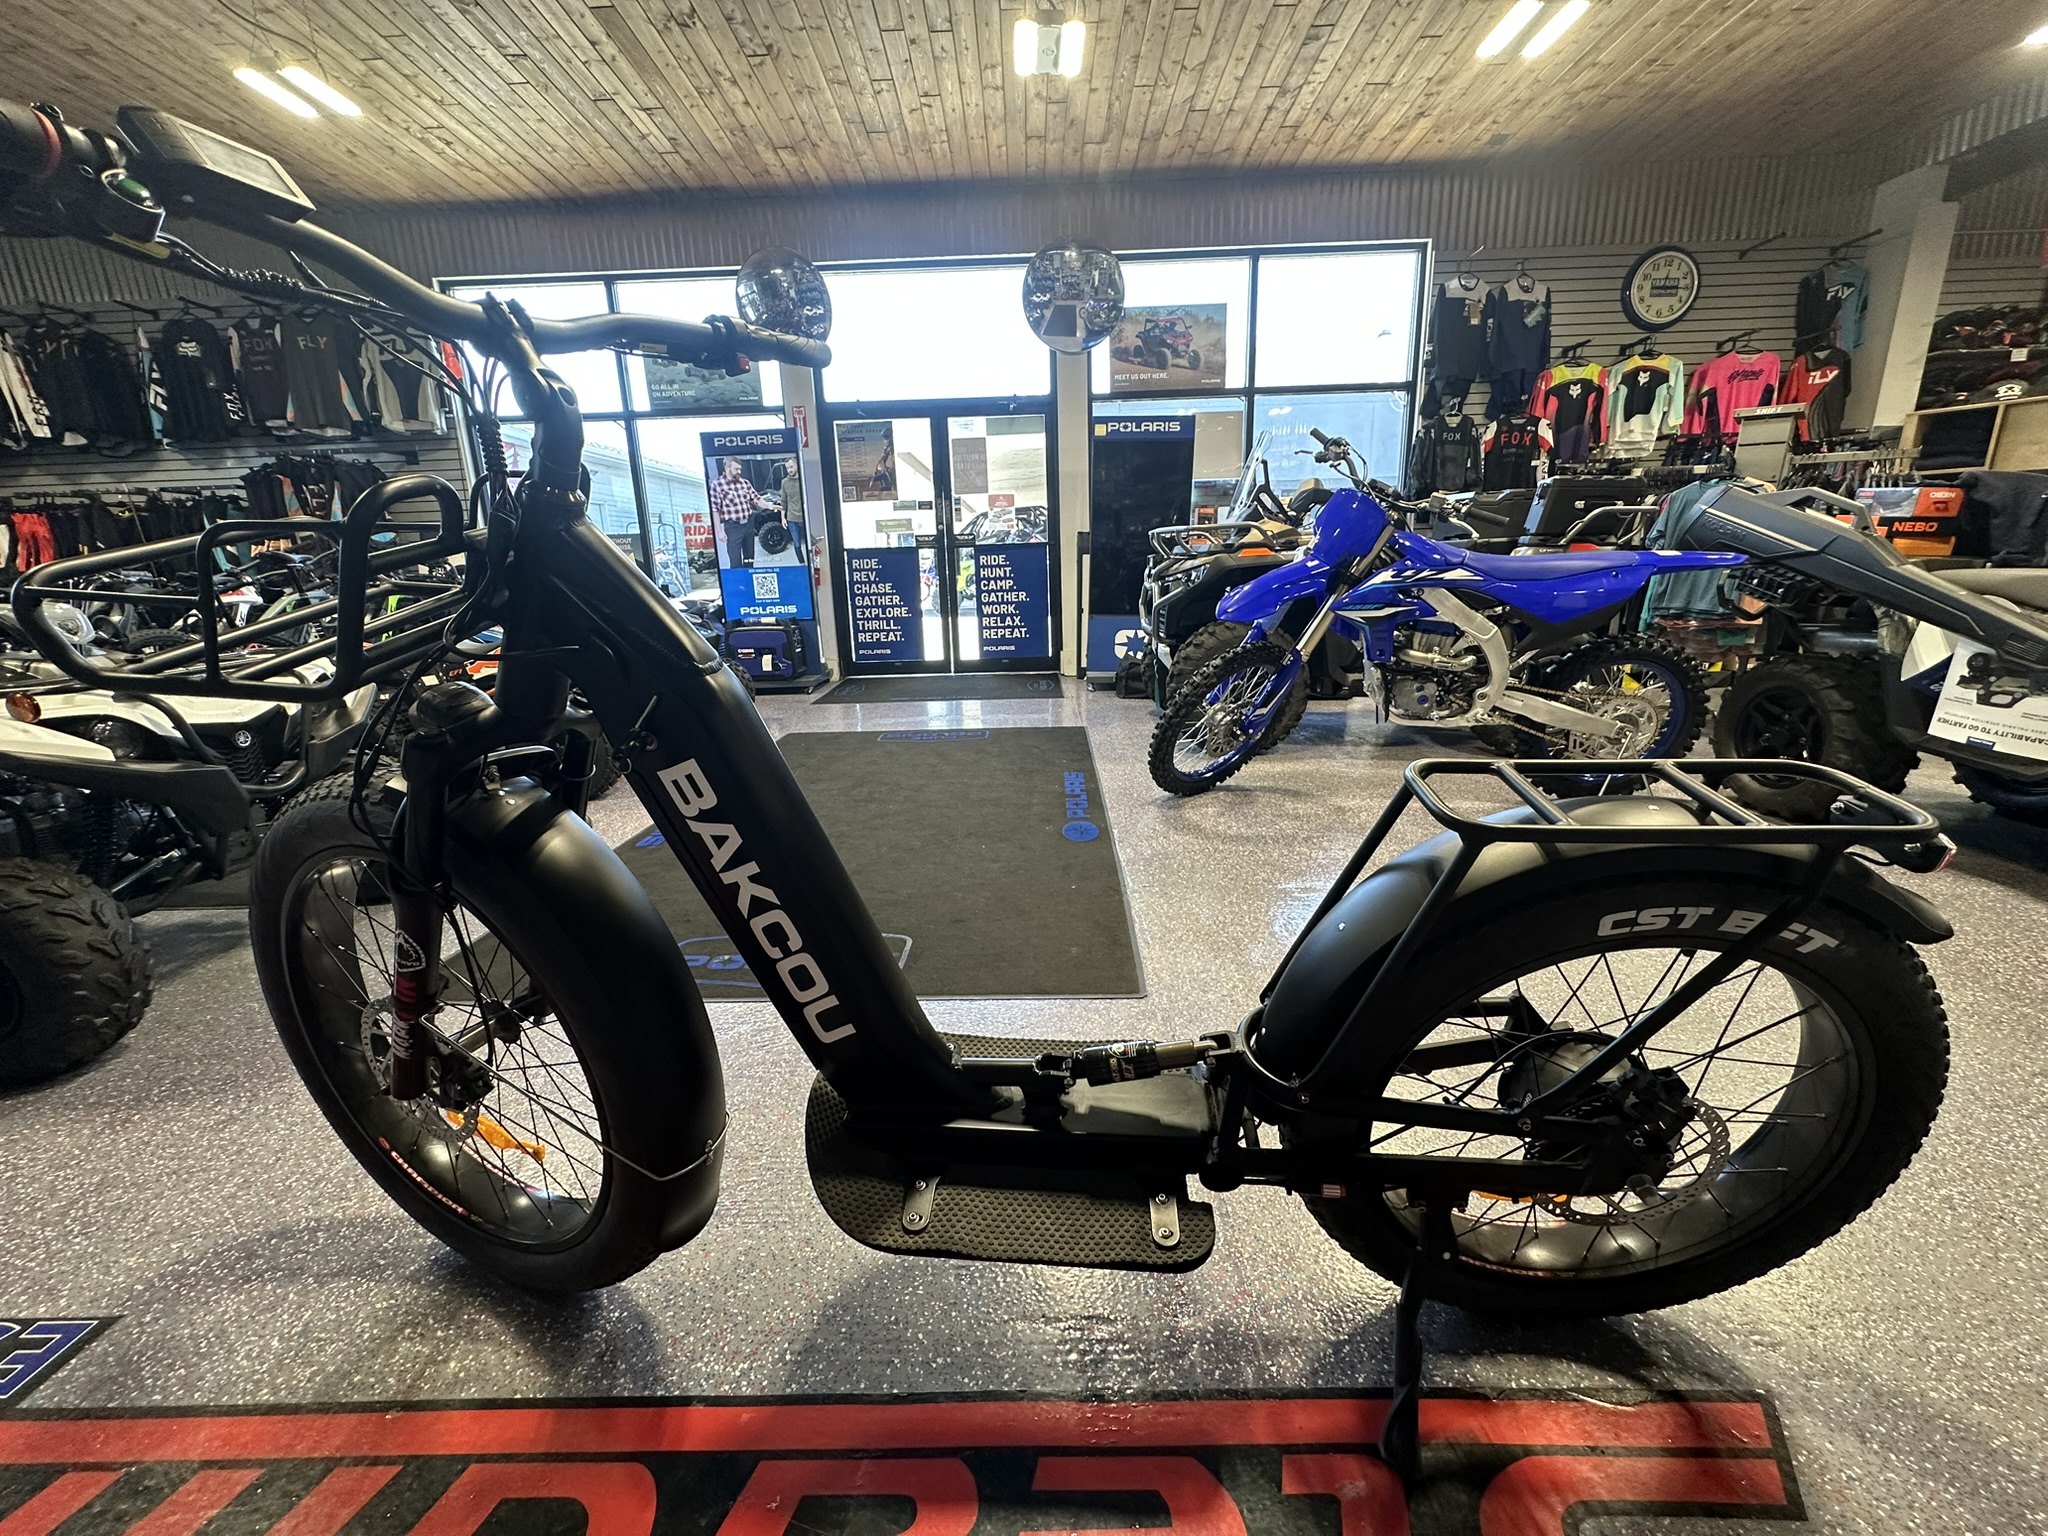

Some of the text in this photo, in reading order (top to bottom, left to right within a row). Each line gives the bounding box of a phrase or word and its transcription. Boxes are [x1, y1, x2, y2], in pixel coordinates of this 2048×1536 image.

[1652, 263, 1660, 271] 11
[1664, 258, 1674, 267] 12
[1677, 262, 1682, 270] 1
[1643, 273, 1652, 281] 10
[1682, 272, 1689, 280] 2
[1637, 284, 1643, 292] 9
[1826, 284, 1856, 301] FLY
[1638, 296, 1645, 304] 8
[1645, 305, 1651, 313] 7
[1656, 309, 1662, 318] 6
[1667, 305, 1674, 313] 5
[297, 335, 328, 350] FLY
[1807, 369, 1841, 385] FLY
[1754, 406, 1783, 415] SHIFT
[1107, 421, 1181, 433] POLARIS
[713, 434, 784, 447] POLARIS
[1442, 432, 1461, 441] FOX
[1500, 431, 1533, 446] FOX
[682, 513, 703, 523] WE
[684, 526, 713, 536] RIDE
[1703, 515, 1747, 542] KOLPIN
[1892, 521, 1938, 532] NEBO
[852, 558, 882, 569] RIDE.
[979, 554, 1010, 566] RIDE.
[853, 571, 879, 582] REV.
[980, 567, 1014, 578] HUNT.
[854, 583, 897, 594] CHASE.
[980, 579, 1017, 590] CAMP.
[855, 595, 904, 606] GATHER.
[981, 591, 1030, 603] GATHER.
[740, 605, 798, 615] POLARIS
[856, 607, 912, 619] EXPLORE.
[981, 604, 1019, 615] WORK.
[857, 619, 901, 630] THRILL.
[982, 616, 1025, 627] RELAX.
[858, 631, 905, 643] REPEAT.
[983, 628, 1030, 639] REPEAT.
[1937, 716, 1967, 729] FARTHER
[1980, 726, 1991, 734] TO
[657, 758, 857, 1044] BAKCOU
[1597, 906, 1715, 937] CST
